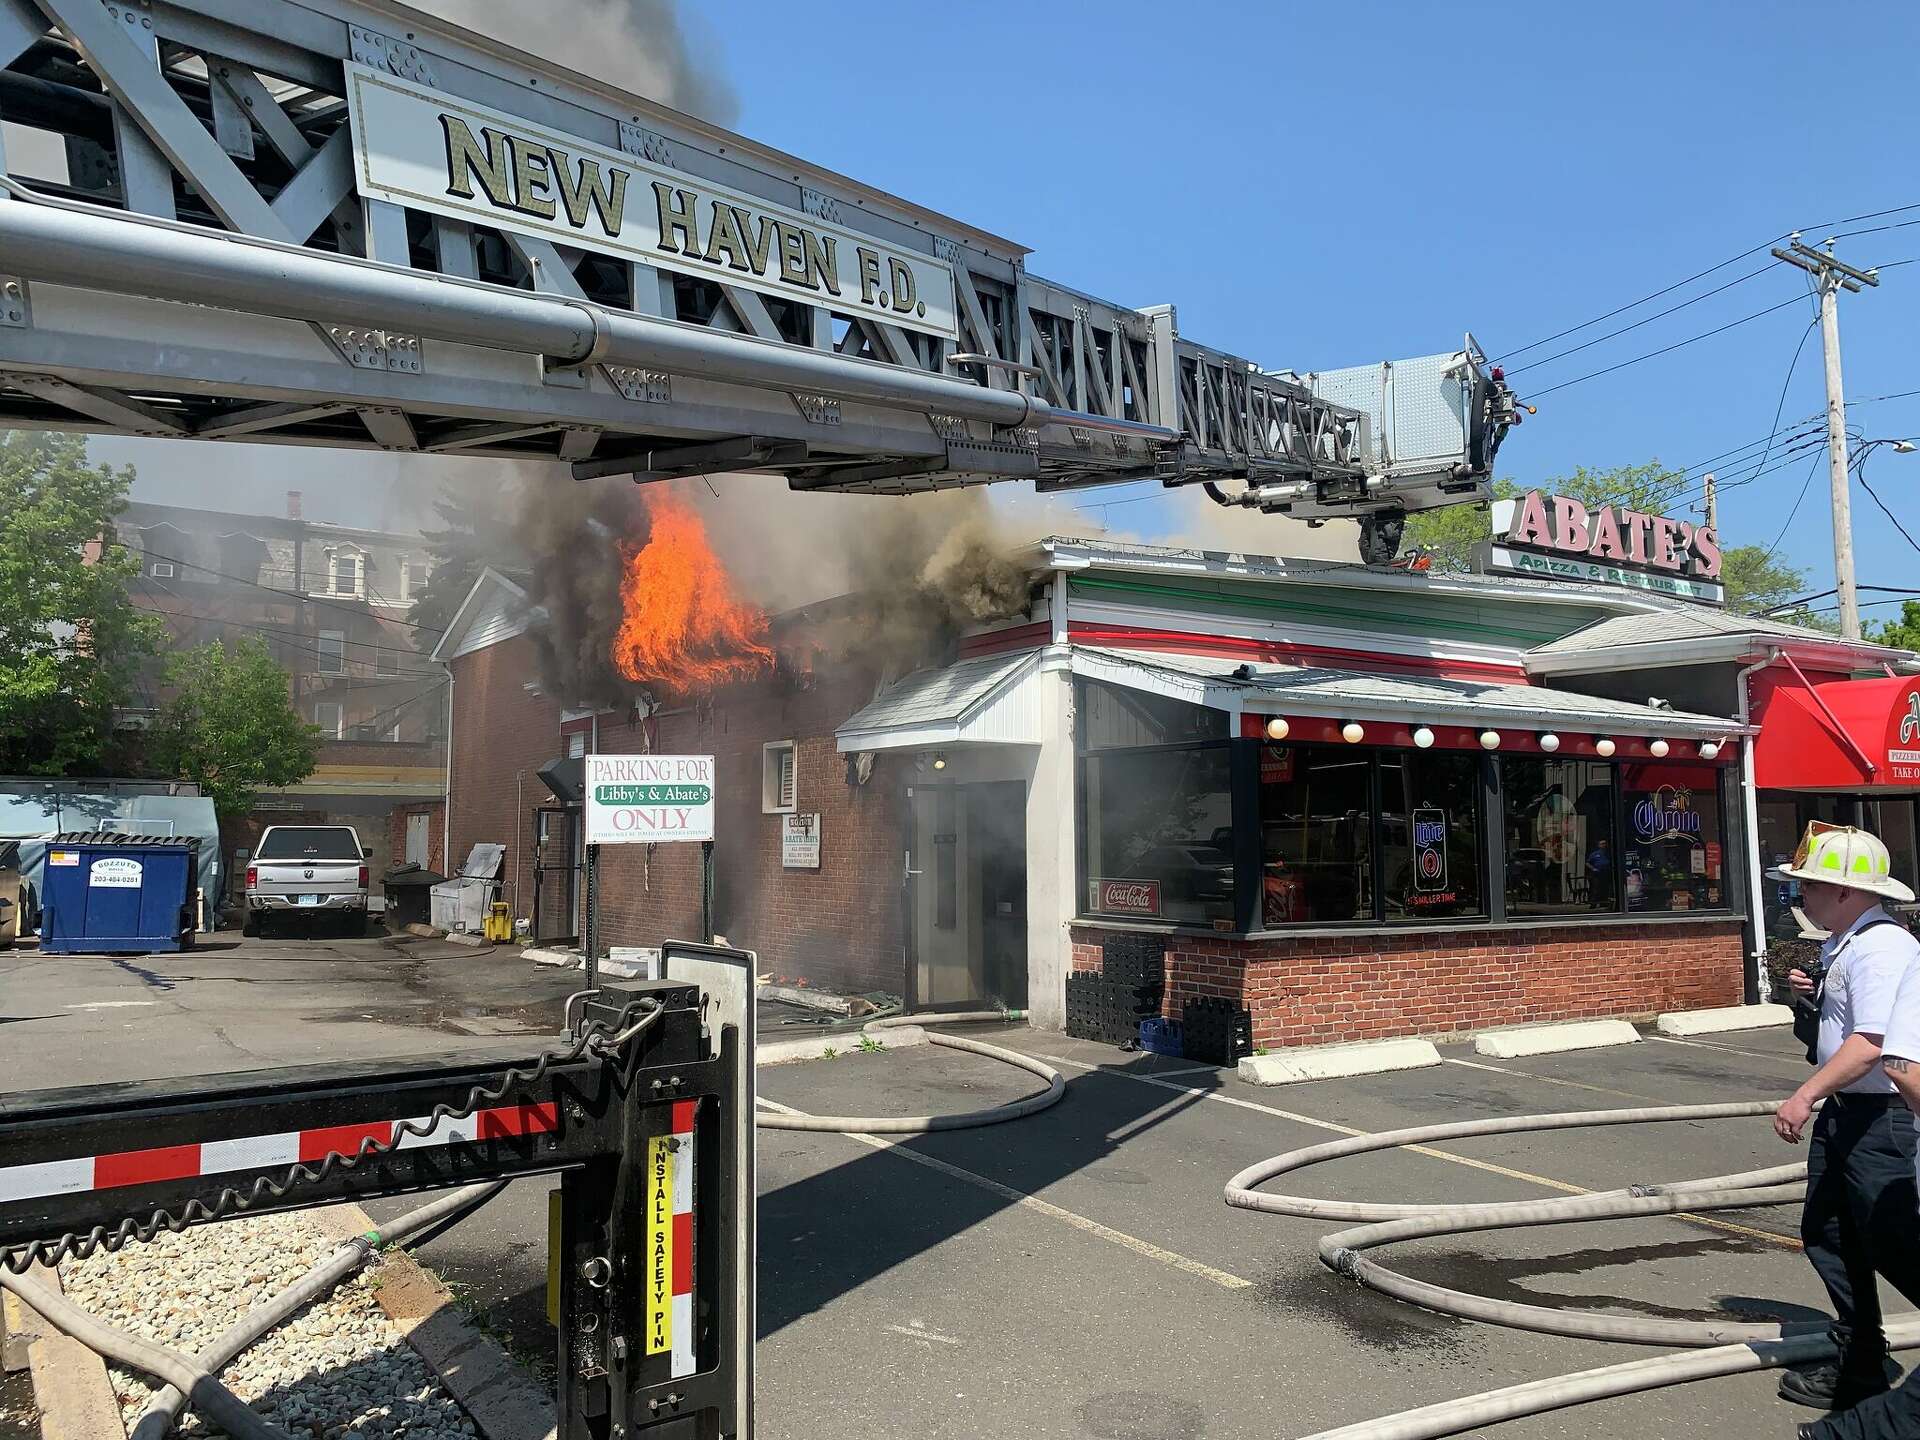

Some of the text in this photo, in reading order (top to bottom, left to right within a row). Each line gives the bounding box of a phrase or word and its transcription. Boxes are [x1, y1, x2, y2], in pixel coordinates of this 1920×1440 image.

[437, 112, 925, 319] NEW HAVEN F.D.
[1516, 488, 1722, 577] ABATE'S
[1589, 566, 1600, 576] &
[594, 760, 709, 781] PARKING FOR
[1892, 767, 1913, 778] TAKE
[600, 787, 708, 803] Libby's & Abate's
[612, 808, 692, 831] ONLY
[1635, 800, 1701, 838] Corona
[1416, 822, 1443, 848] Lite
[98, 860, 137, 869] BOZZUTO
[655, 1140, 666, 1348] INSTALL SAFETY PIN
